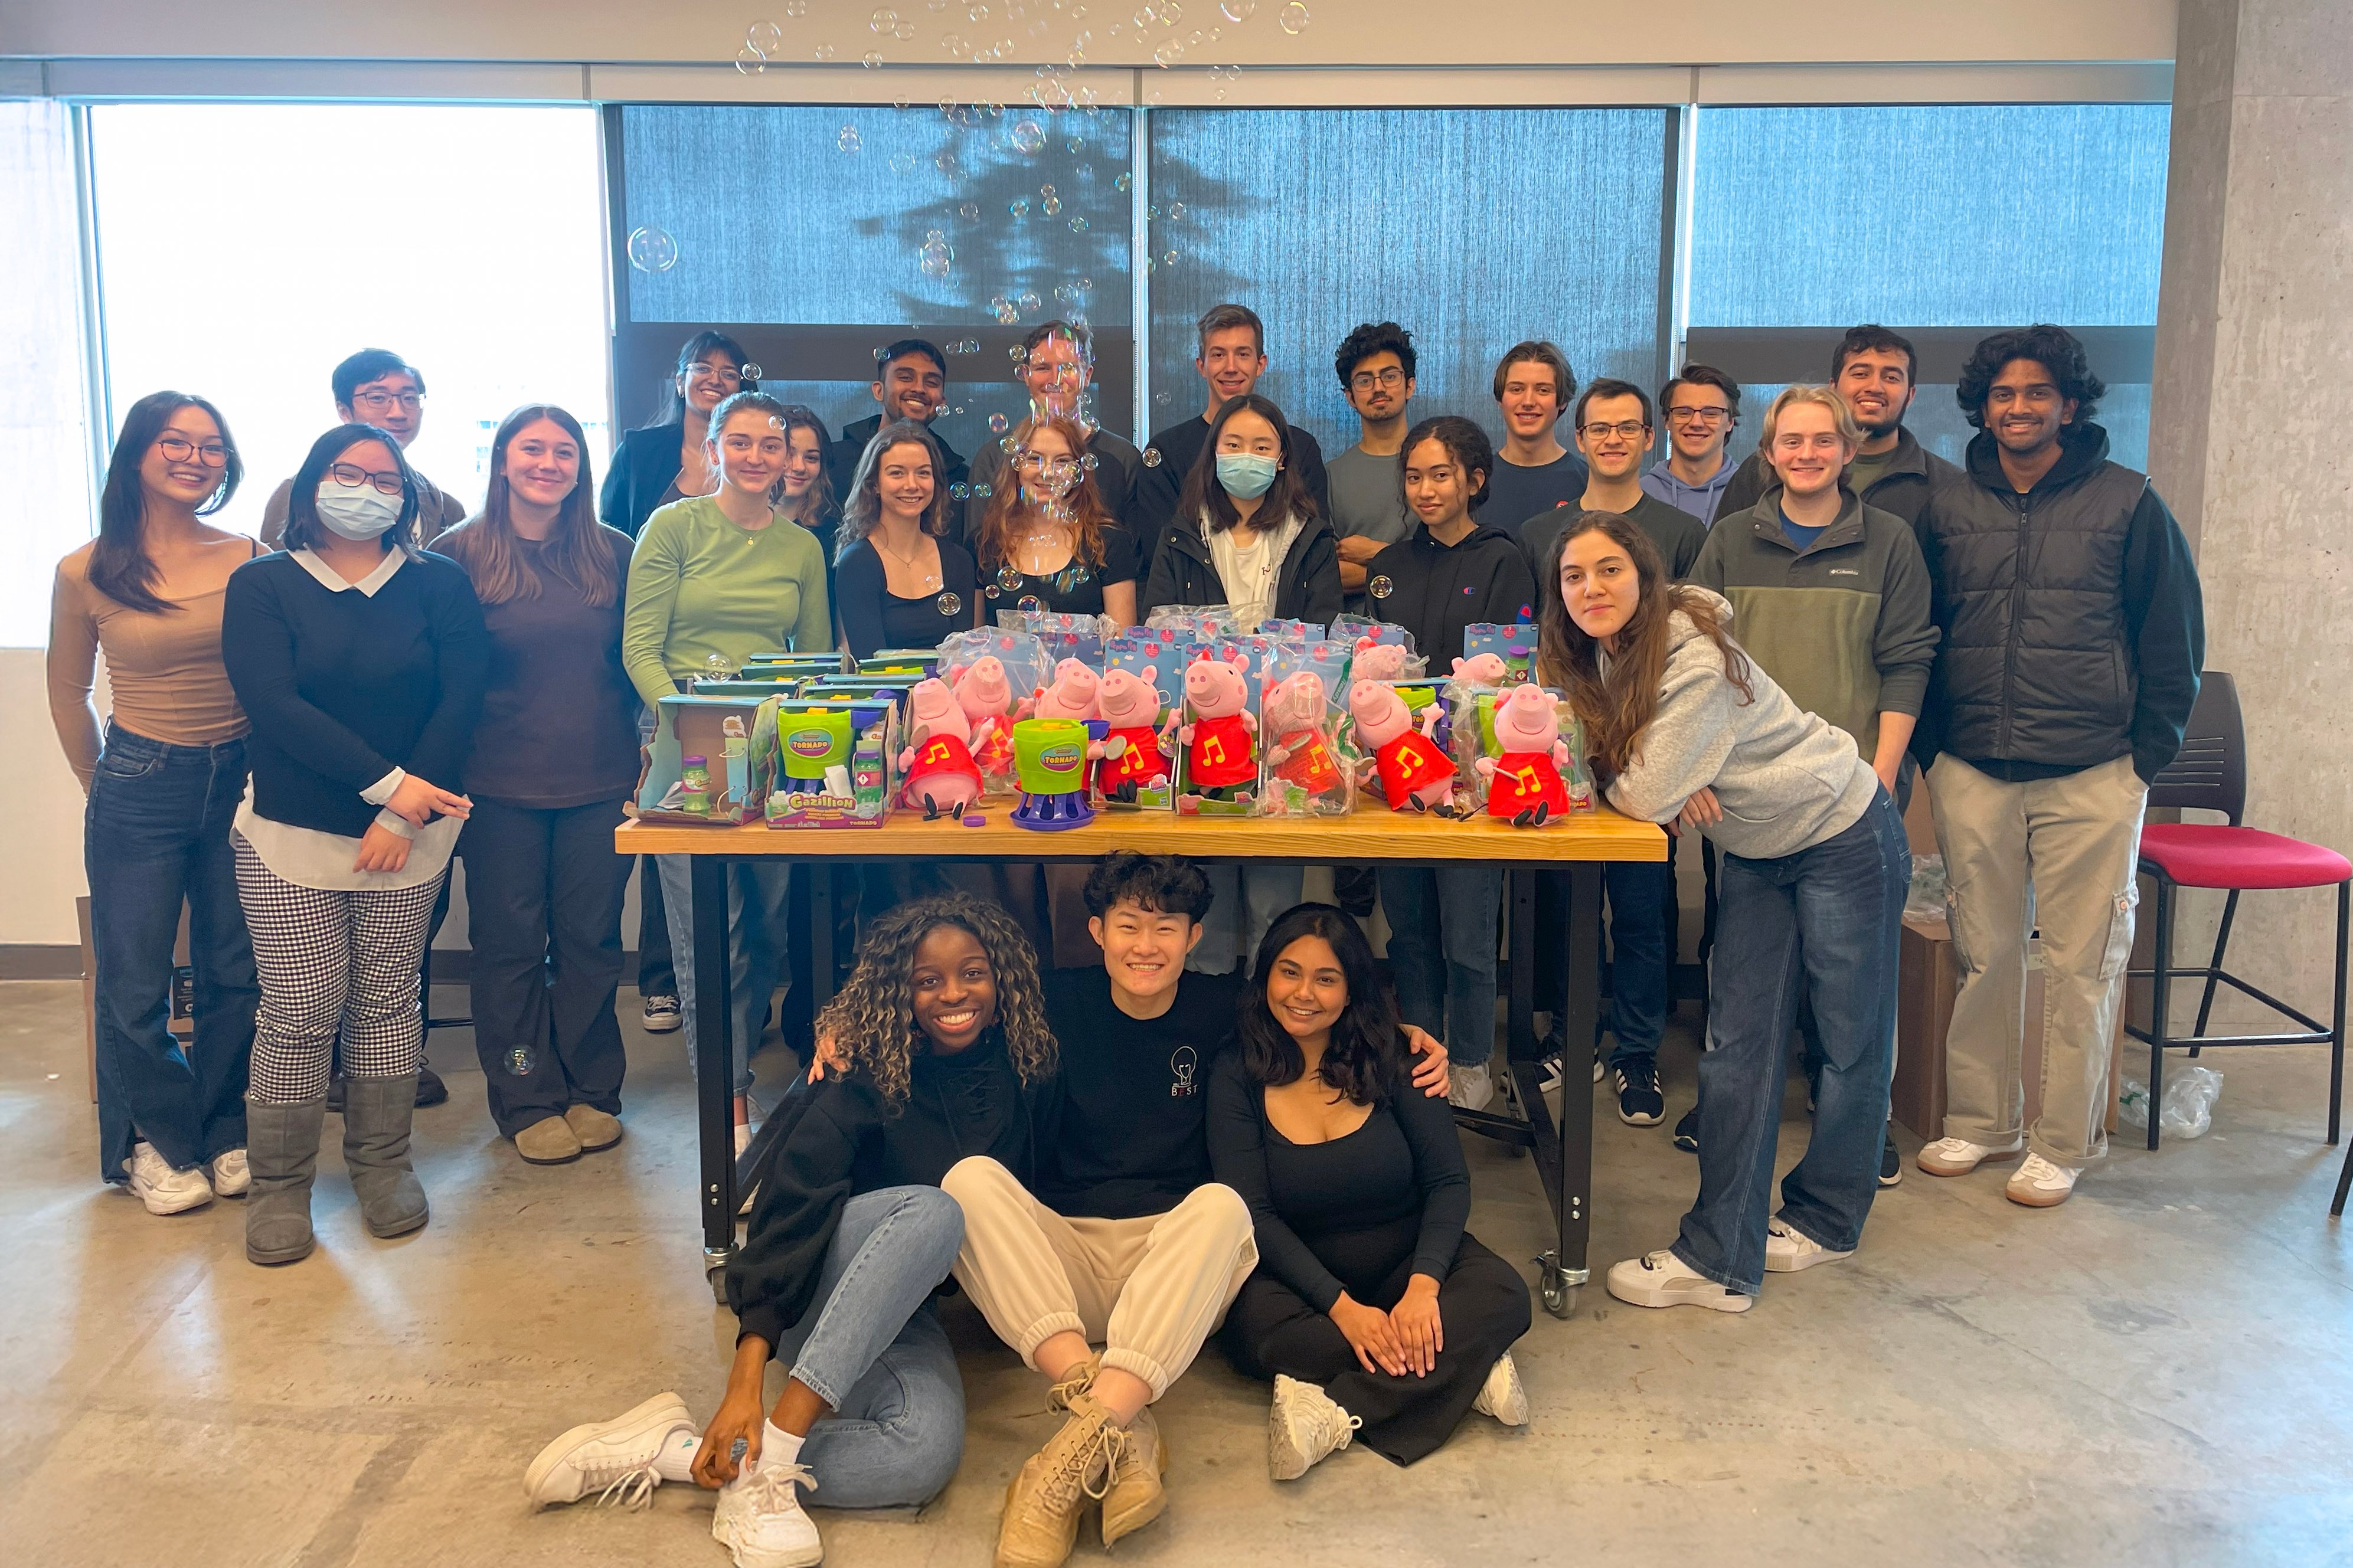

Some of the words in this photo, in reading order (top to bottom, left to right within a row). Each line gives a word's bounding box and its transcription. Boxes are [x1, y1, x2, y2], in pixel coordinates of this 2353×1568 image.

[1332, 679, 1346, 702] Ready
[1044, 755, 1077, 764] TORNADO
[1172, 1085, 1198, 1096] BEST
